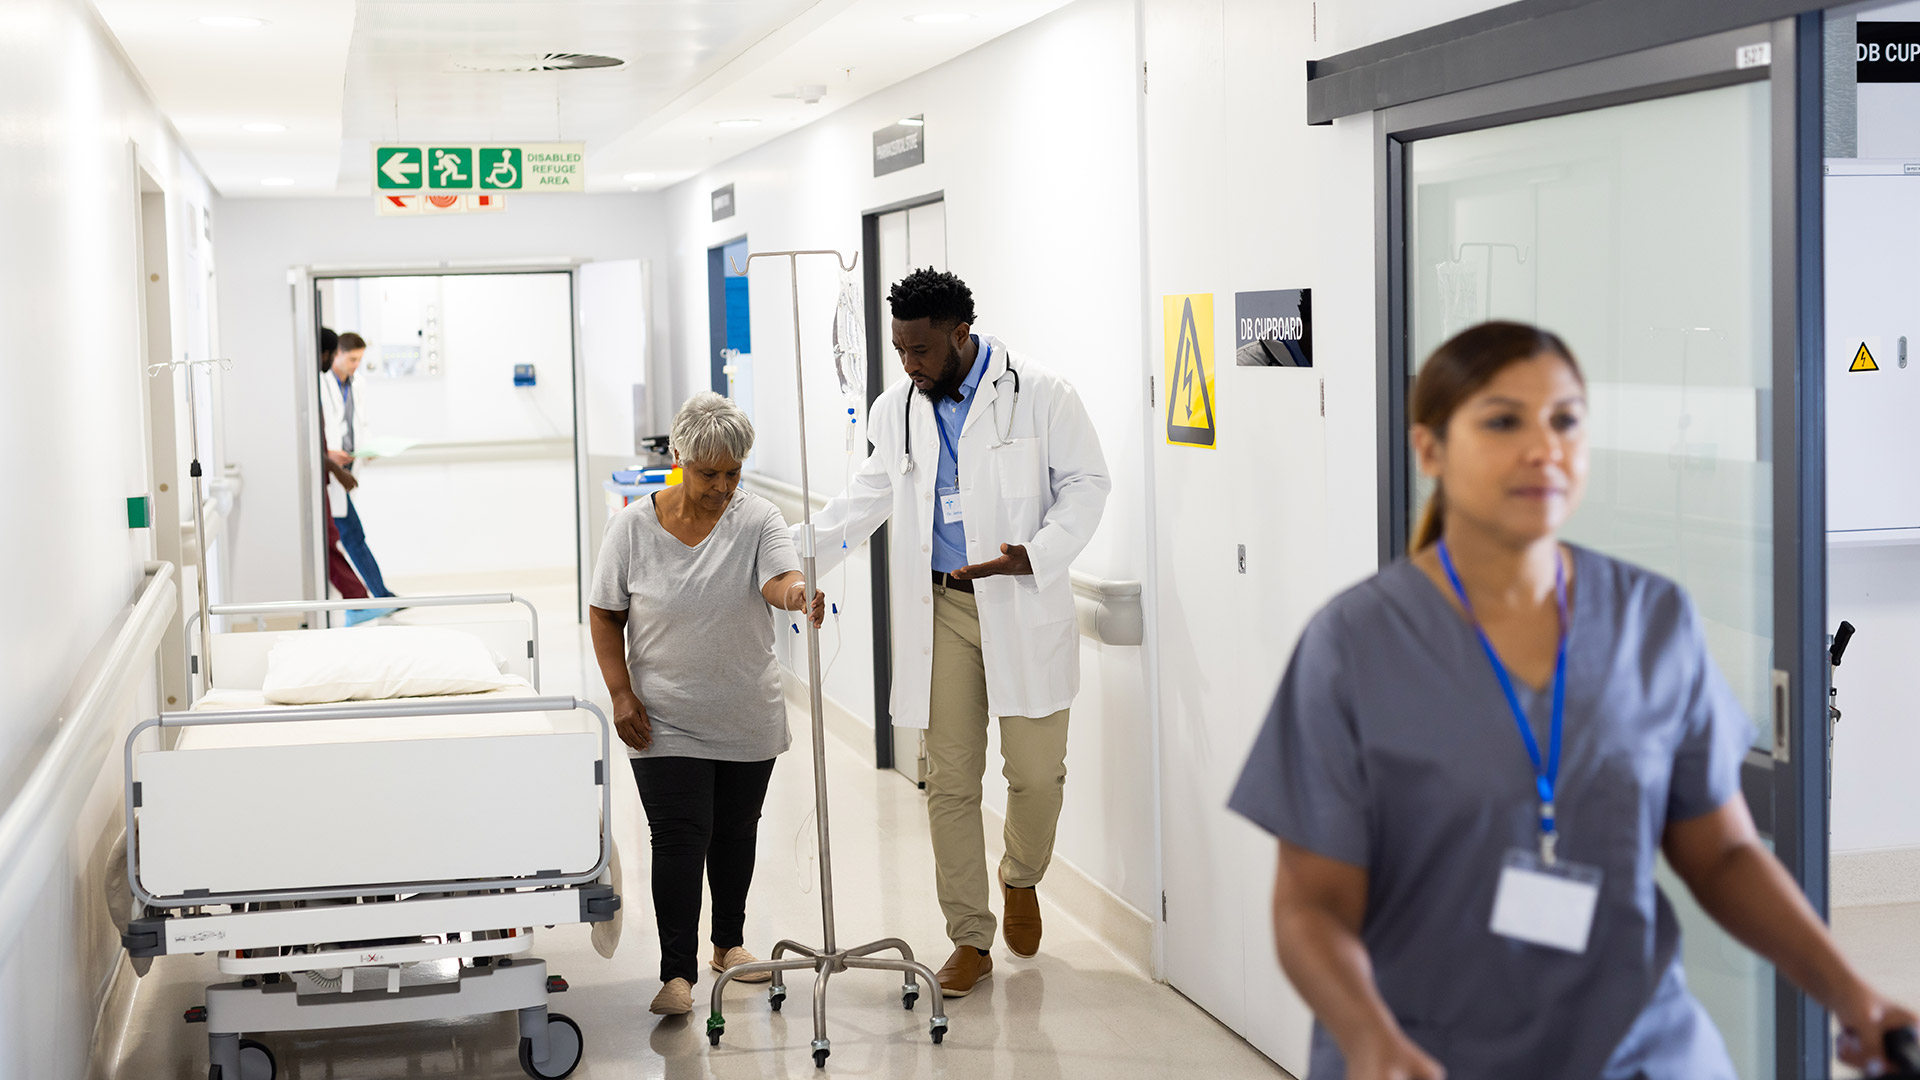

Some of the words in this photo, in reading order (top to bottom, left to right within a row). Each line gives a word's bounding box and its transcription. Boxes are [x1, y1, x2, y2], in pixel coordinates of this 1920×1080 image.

[1856, 43, 1881, 62] DB
[1885, 42, 1920, 62] CUP
[527, 153, 581, 162] DISABLED
[532, 164, 576, 174] REFUGE
[539, 176, 570, 185] AREA
[1240, 317, 1253, 340] DB
[1254, 316, 1303, 340] CUPBOARD
